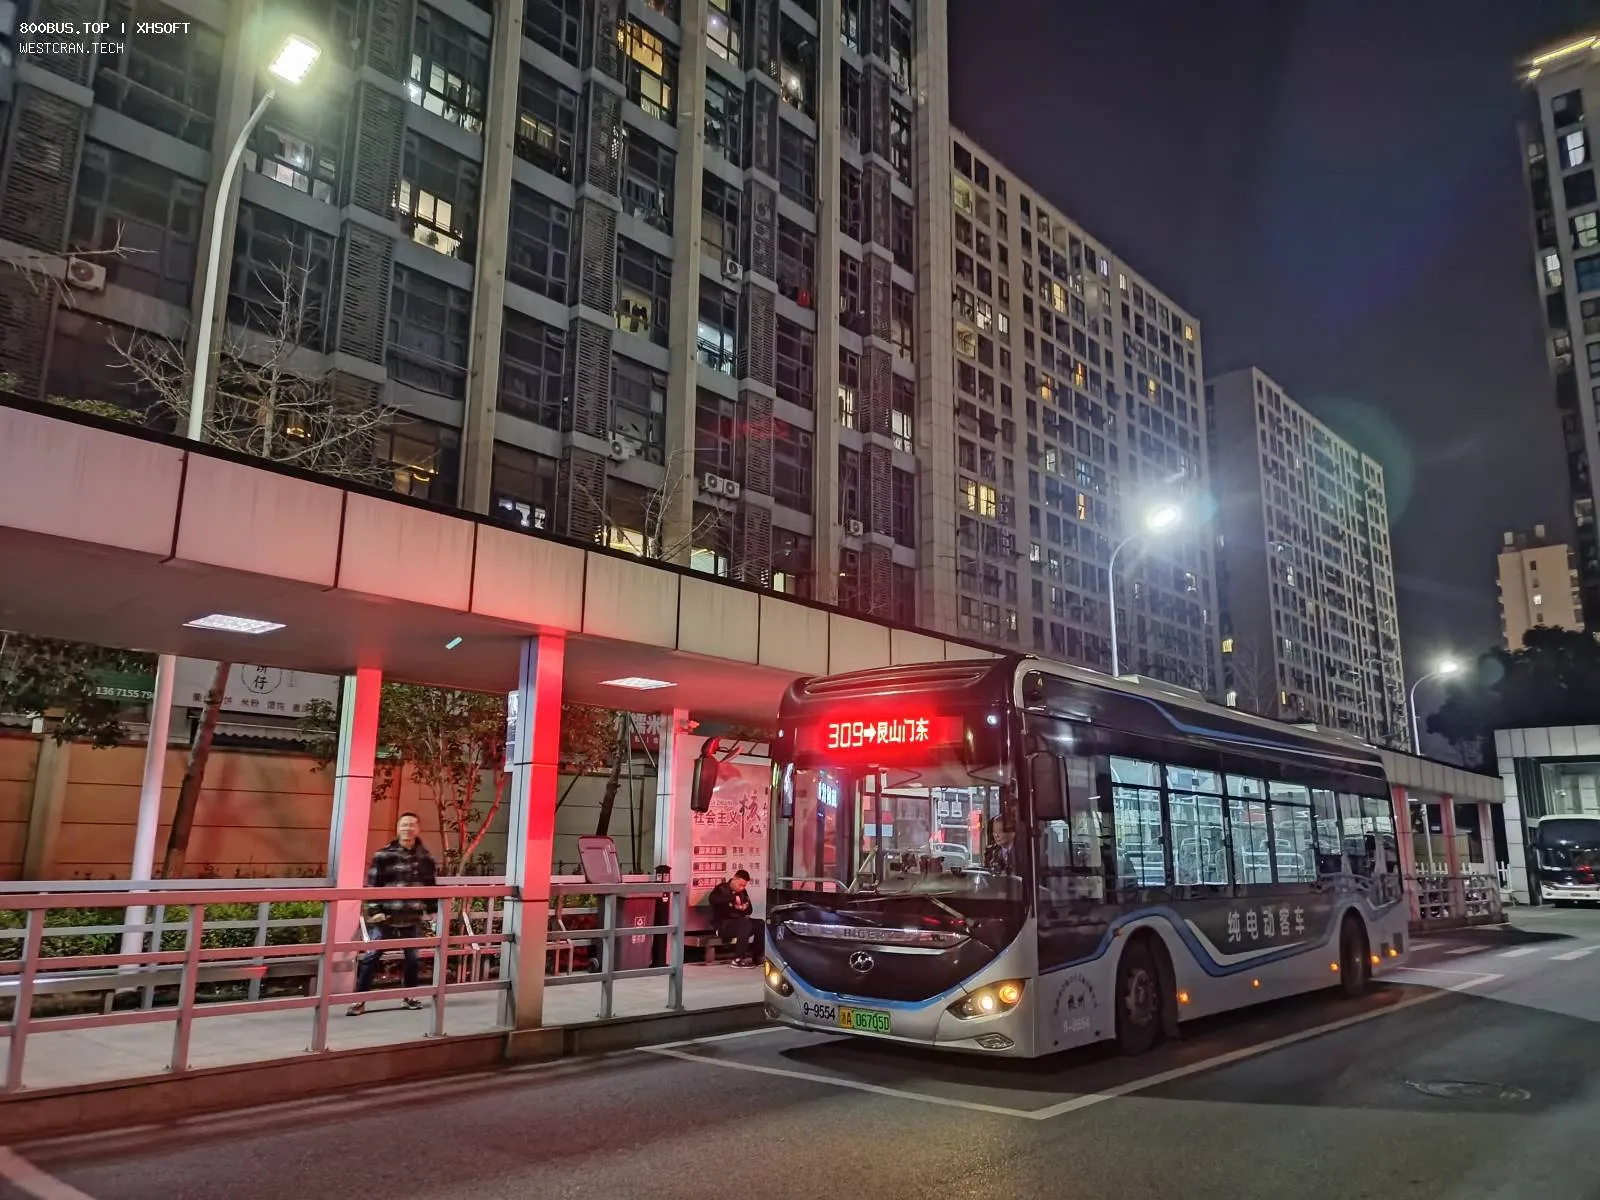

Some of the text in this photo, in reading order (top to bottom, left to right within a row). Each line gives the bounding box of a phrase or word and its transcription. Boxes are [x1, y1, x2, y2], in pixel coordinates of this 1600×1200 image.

[95, 686, 154, 699] 136 7155 79
[828, 717, 929, 749] 309 艮山门东
[694, 809, 738, 825] 社会主义
[1227, 906, 1305, 943] 纯电动客车
[803, 1002, 836, 1021] 9-9554
